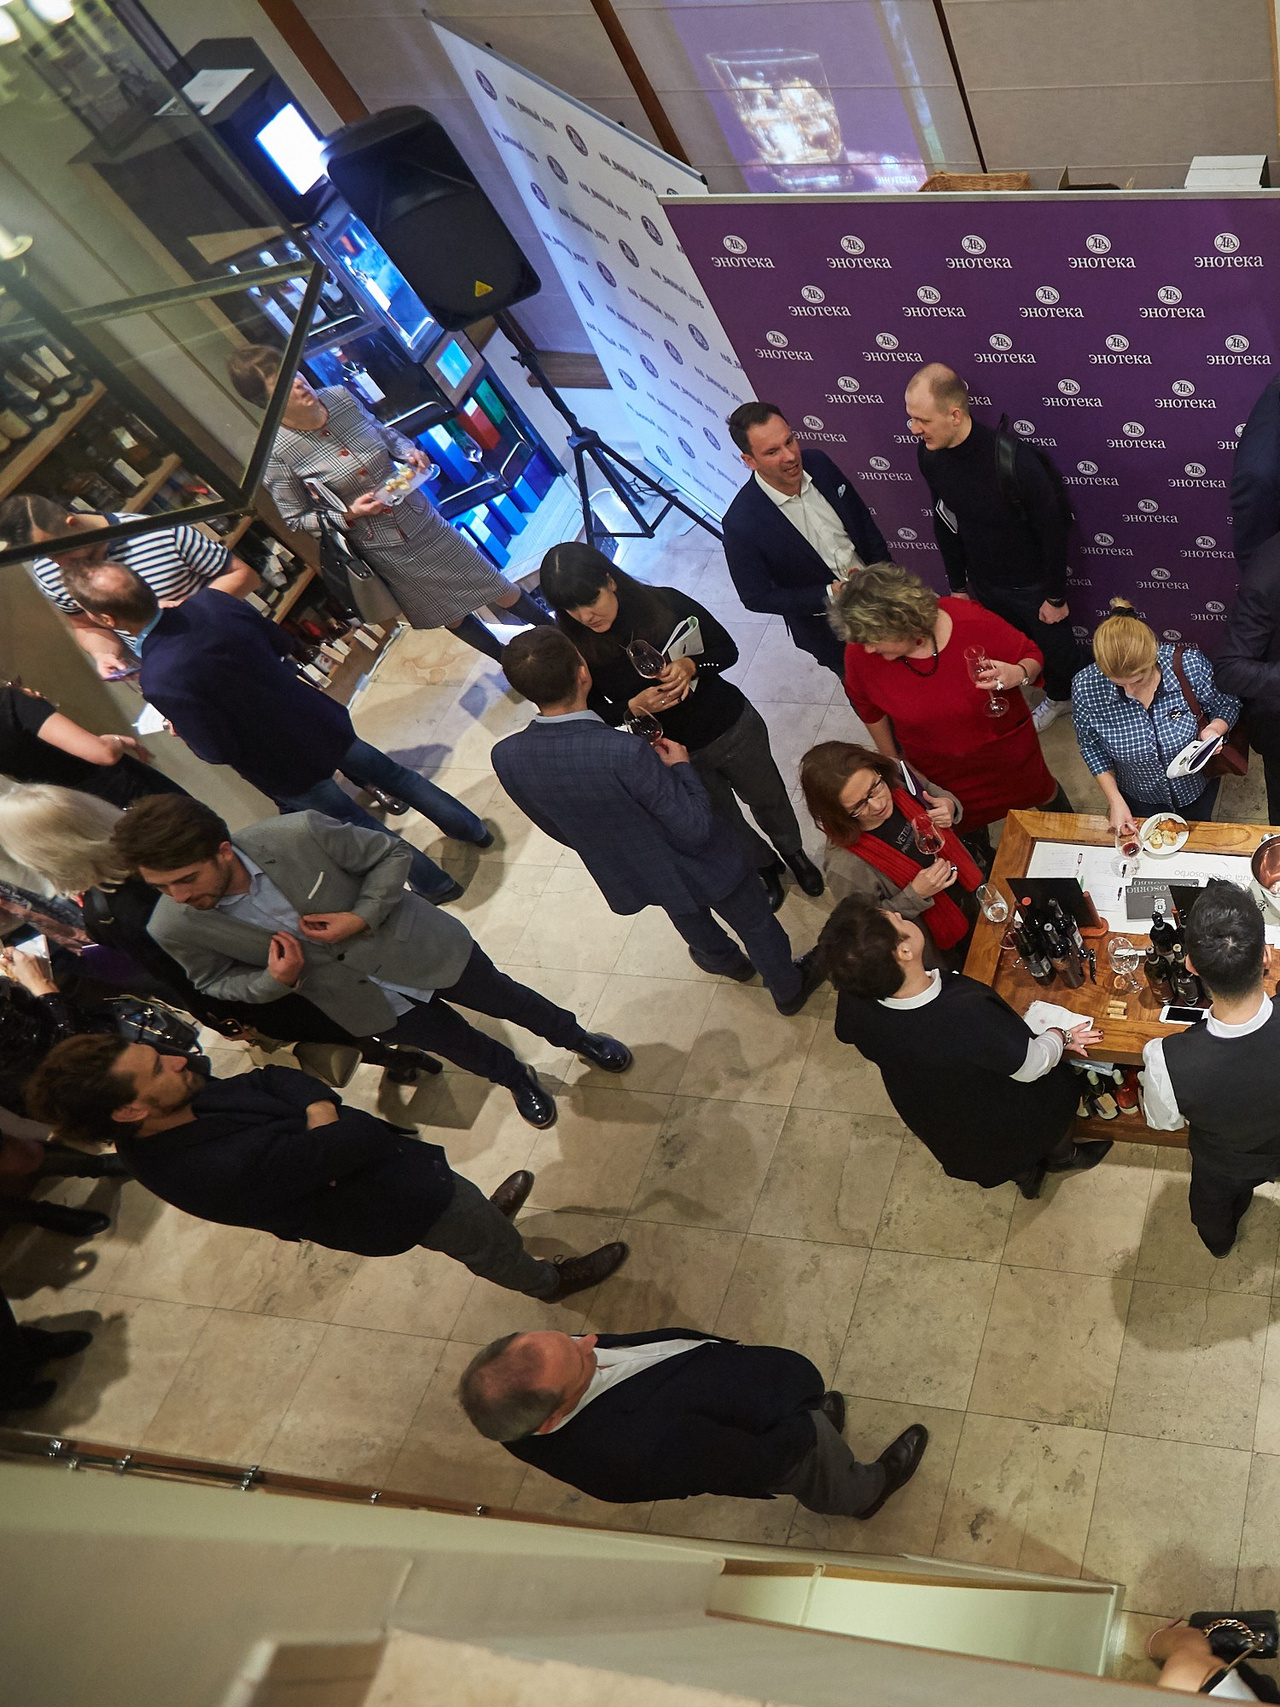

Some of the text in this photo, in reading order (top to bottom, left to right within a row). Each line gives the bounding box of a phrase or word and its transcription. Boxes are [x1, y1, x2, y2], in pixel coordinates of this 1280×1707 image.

[711, 256, 776, 269] энотека
[826, 257, 893, 269] энотека
[945, 257, 1013, 269] энотека
[1067, 256, 1137, 269] энотека
[1194, 255, 1264, 268] энотека
[788, 305, 852, 317] энотека
[902, 306, 967, 318] энотека
[1019, 307, 1085, 318] энотека
[1139, 307, 1206, 319] энотека
[754, 348, 814, 361] энотека
[862, 351, 924, 363] энотека
[973, 353, 1037, 364] энотека
[1088, 354, 1153, 365] энотека
[1206, 354, 1272, 366] энотека
[824, 393, 885, 404] энотека
[1041, 397, 1103, 408] энотека
[1154, 398, 1217, 409] энотека
[791, 430, 848, 444] энотека
[1106, 439, 1167, 449] энотека
[857, 471, 913, 481] энотека
[1062, 476, 1120, 486] энотека
[1167, 478, 1226, 488] энотека
[1190, 613, 1228, 622] эноте
[1126, 884, 1170, 894] OSORBO
